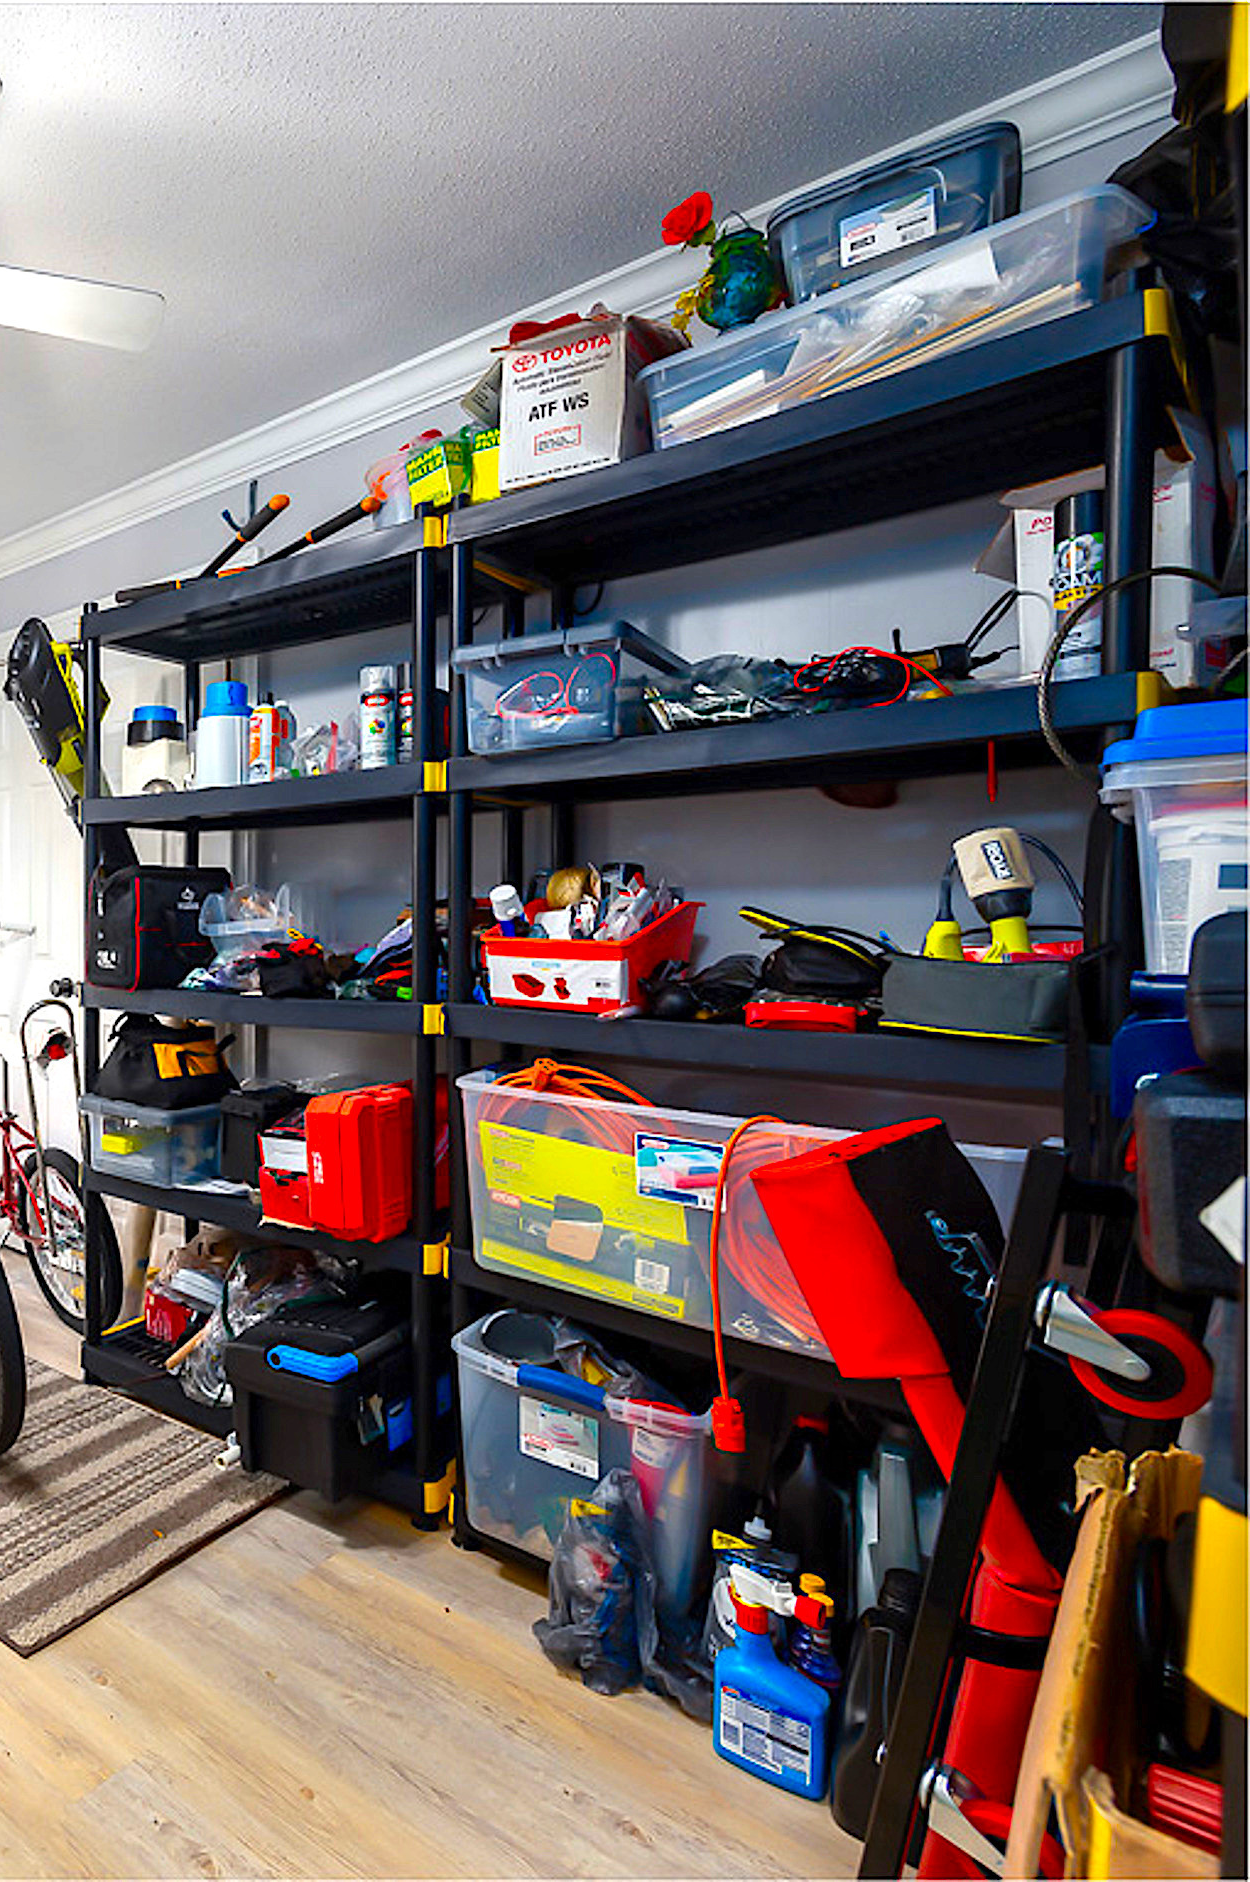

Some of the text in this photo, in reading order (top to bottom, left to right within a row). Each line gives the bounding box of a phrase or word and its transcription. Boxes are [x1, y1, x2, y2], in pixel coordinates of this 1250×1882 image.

[540, 333, 611, 364] TOYOTA
[528, 391, 590, 422] ATF WS
